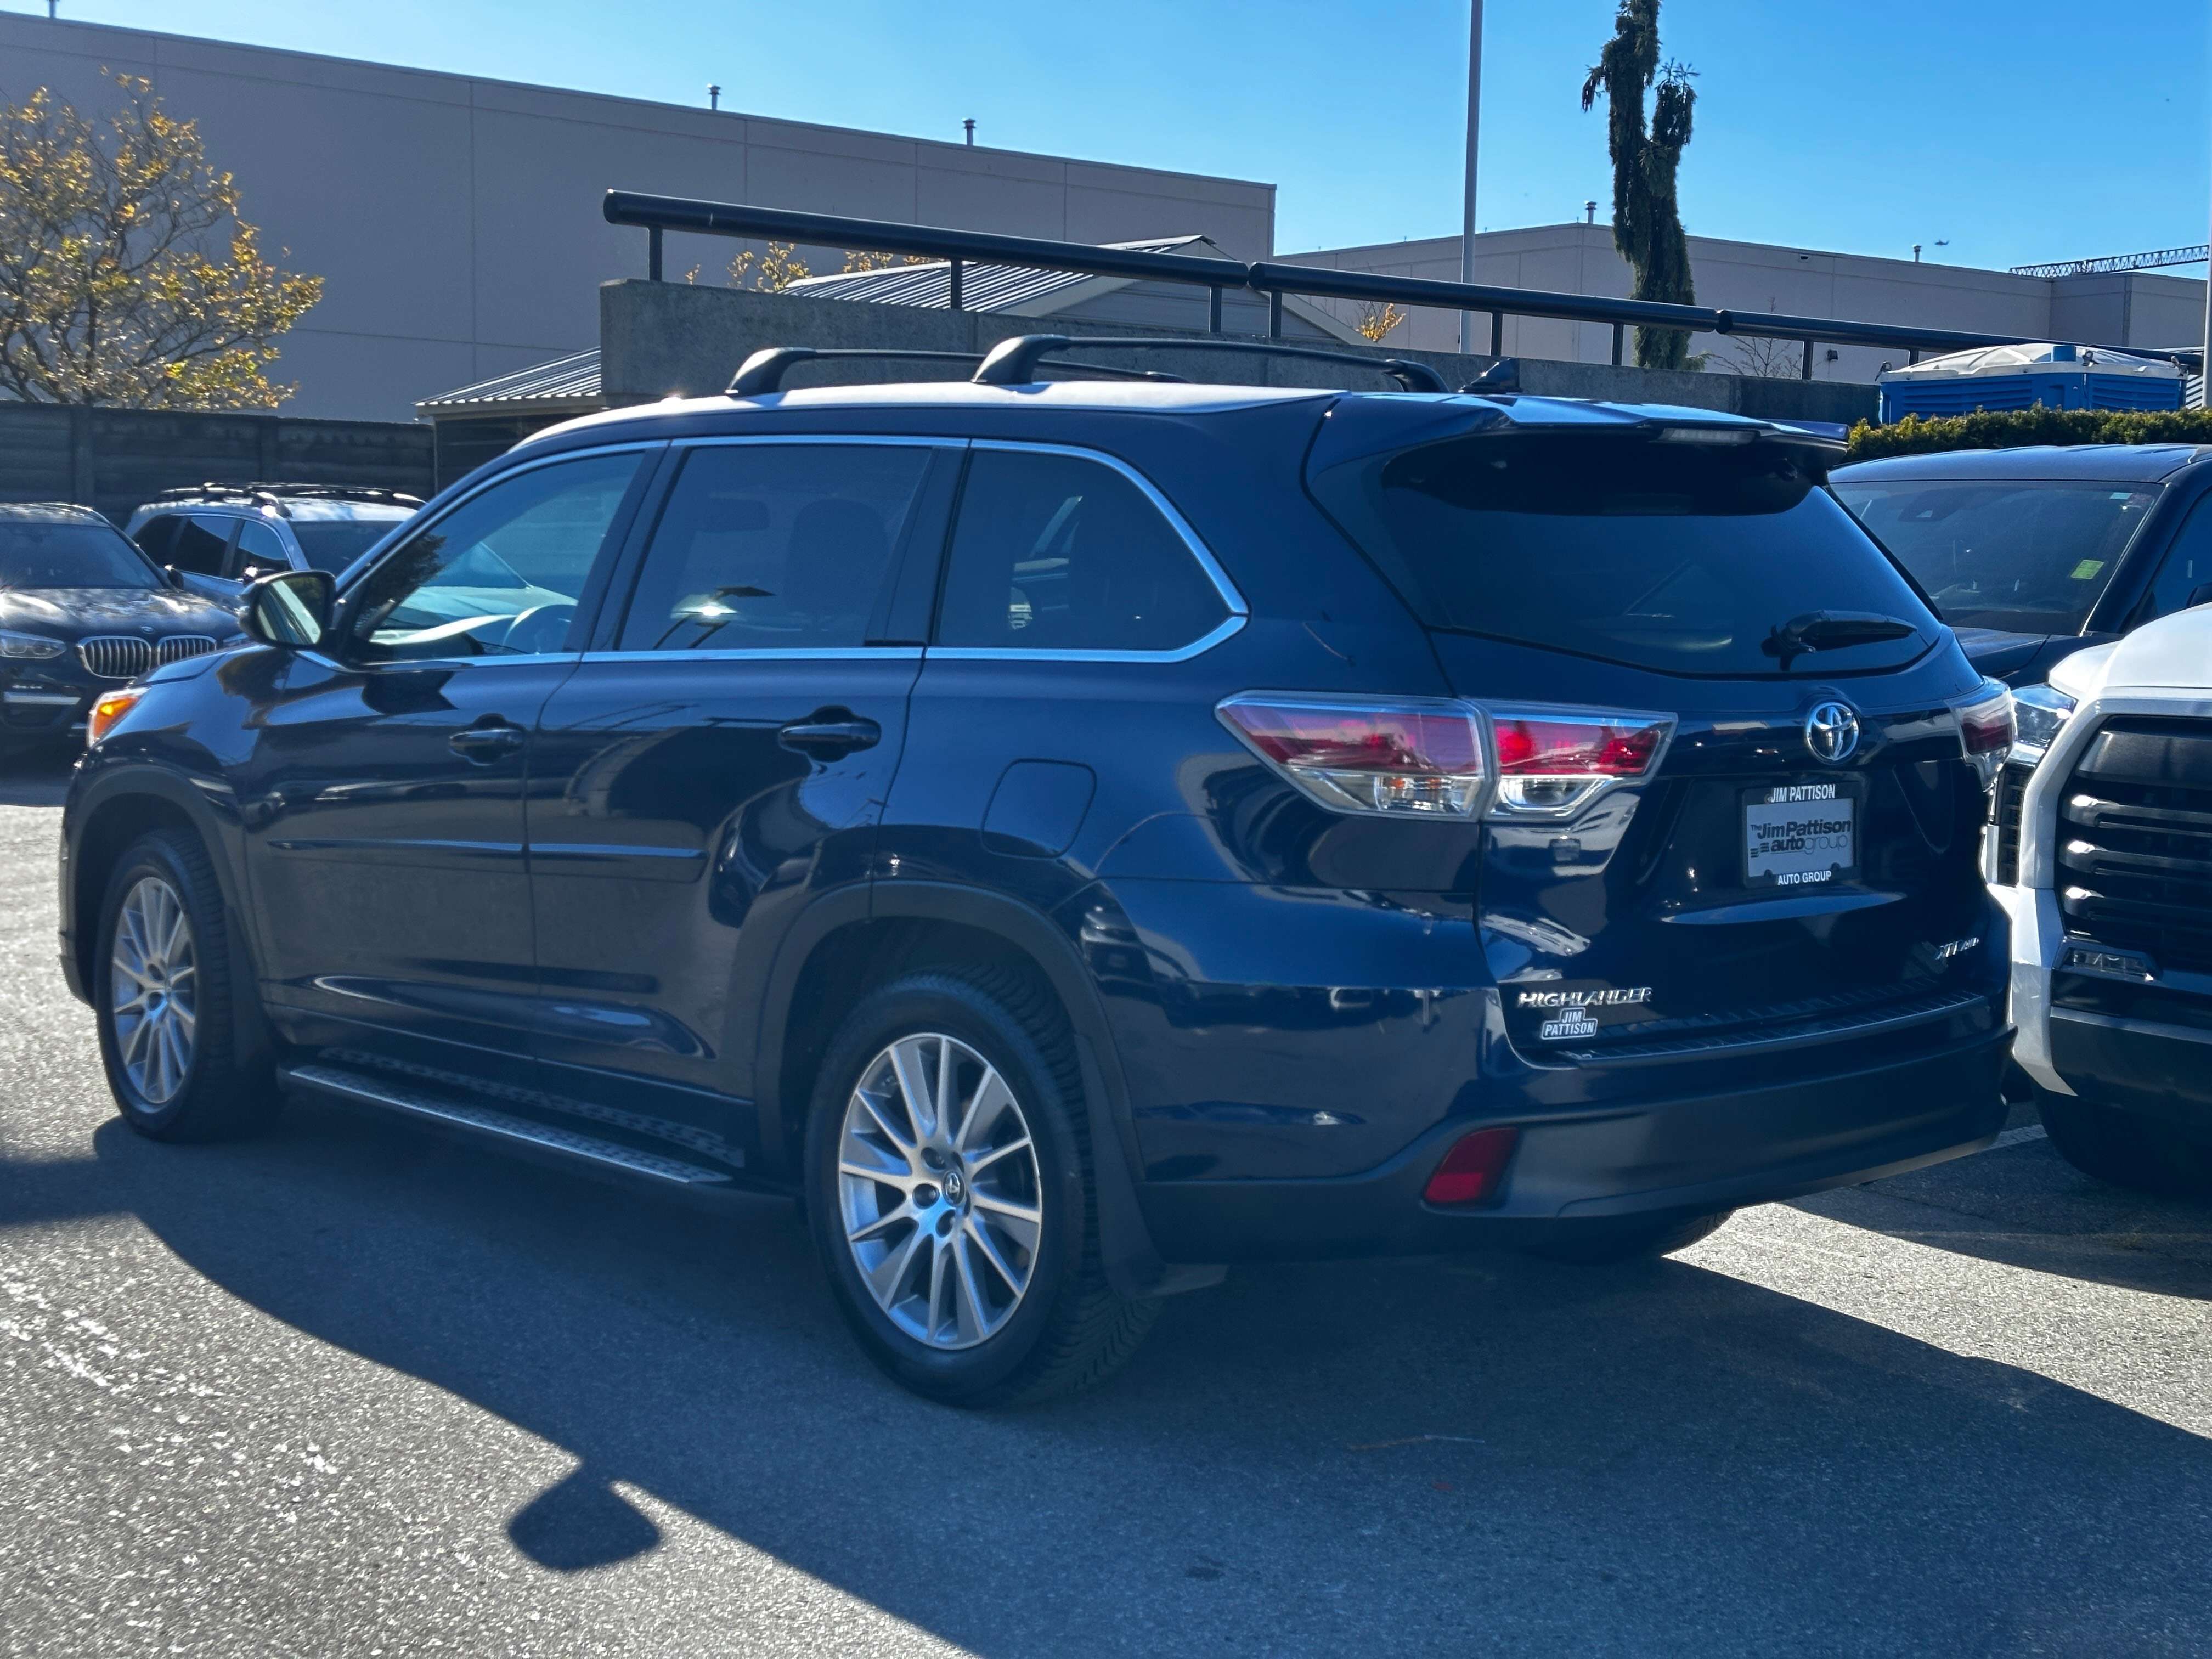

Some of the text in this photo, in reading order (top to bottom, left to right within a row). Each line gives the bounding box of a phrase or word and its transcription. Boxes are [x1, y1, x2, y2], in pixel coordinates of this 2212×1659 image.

[1771, 783, 1836, 803] JIM PATTISON
[1757, 823, 1785, 839] Jim
[1786, 819, 1852, 837] Pattison
[1778, 870, 1832, 886] AUTO GROUP
[1518, 988, 1653, 1007] HIGHLANDER
[1562, 1011, 1582, 1023] JIM
[1545, 1022, 1594, 1036] PATTISON
